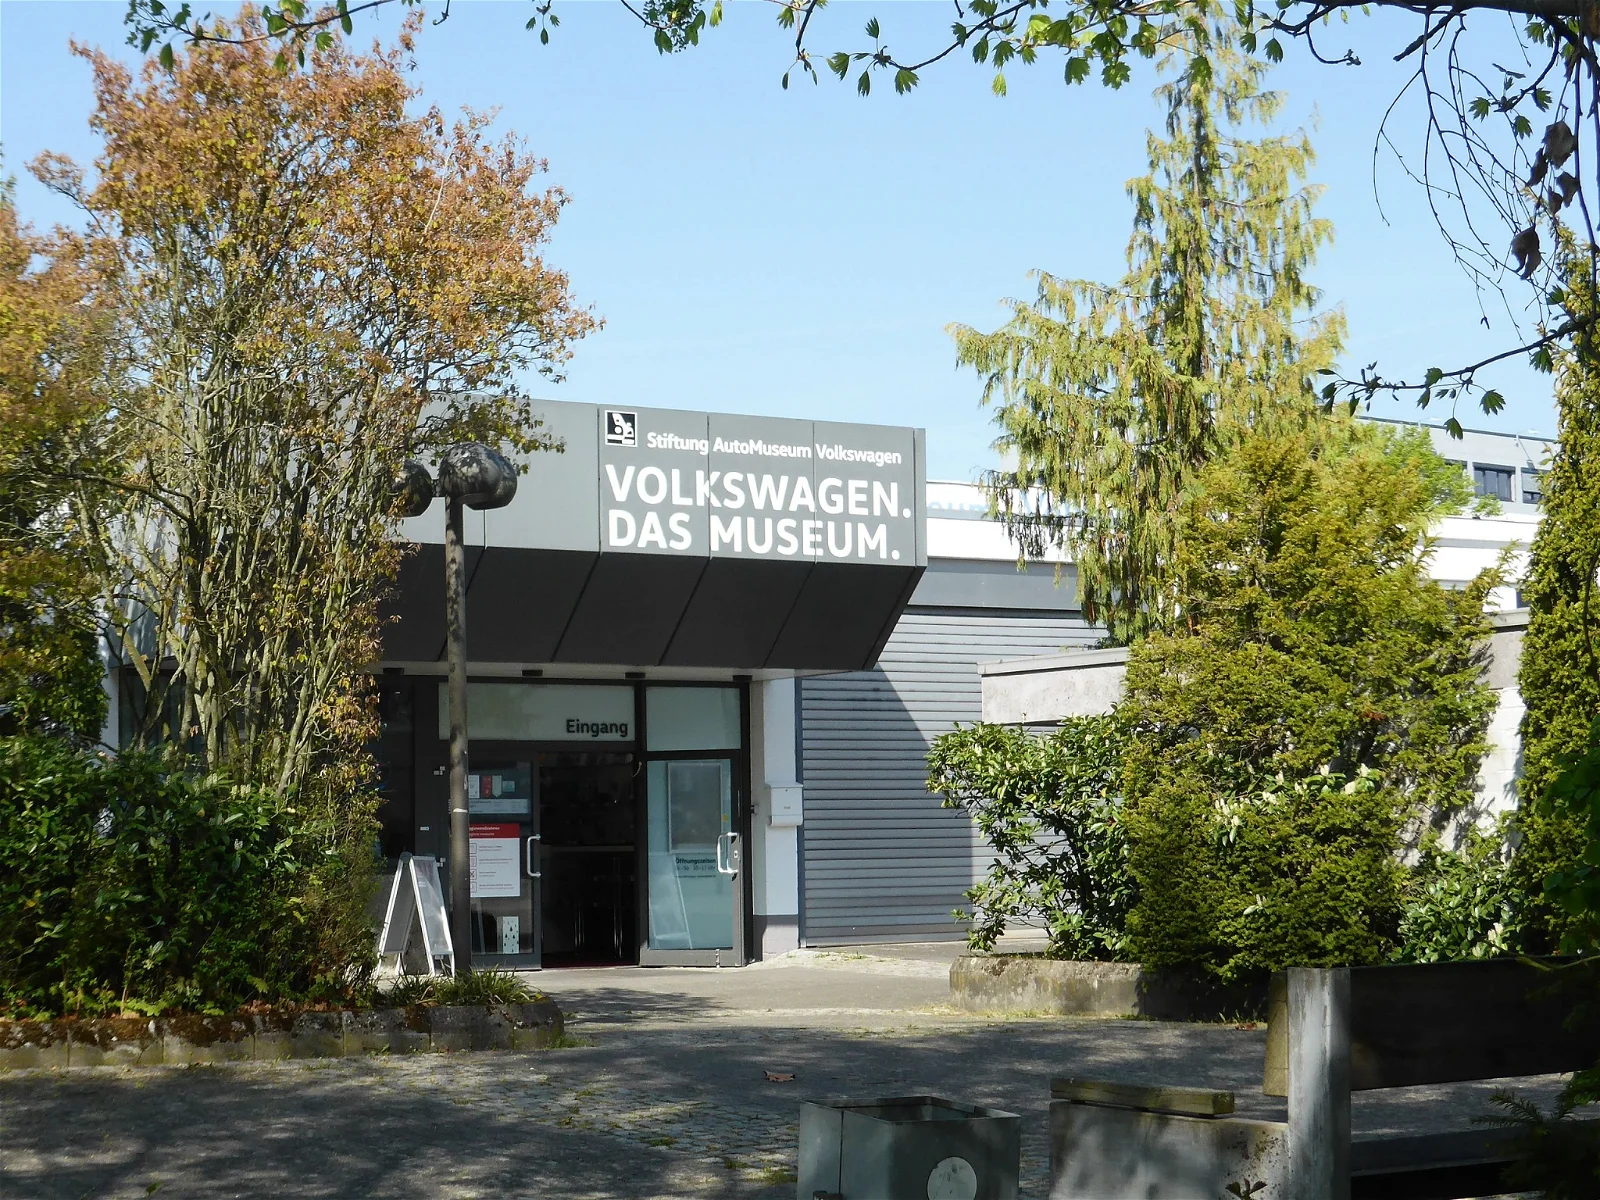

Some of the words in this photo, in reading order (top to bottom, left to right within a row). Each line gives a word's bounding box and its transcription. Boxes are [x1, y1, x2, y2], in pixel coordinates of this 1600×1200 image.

[646, 431, 709, 456] Stiftung
[712, 437, 812, 459] AutoMuseum
[815, 443, 902, 467] Volkswagen
[604, 463, 912, 519] VOLKSWAGEN.
[608, 509, 692, 550] DAS
[709, 514, 900, 560] MUSEUM.
[566, 718, 628, 738] Eingang
